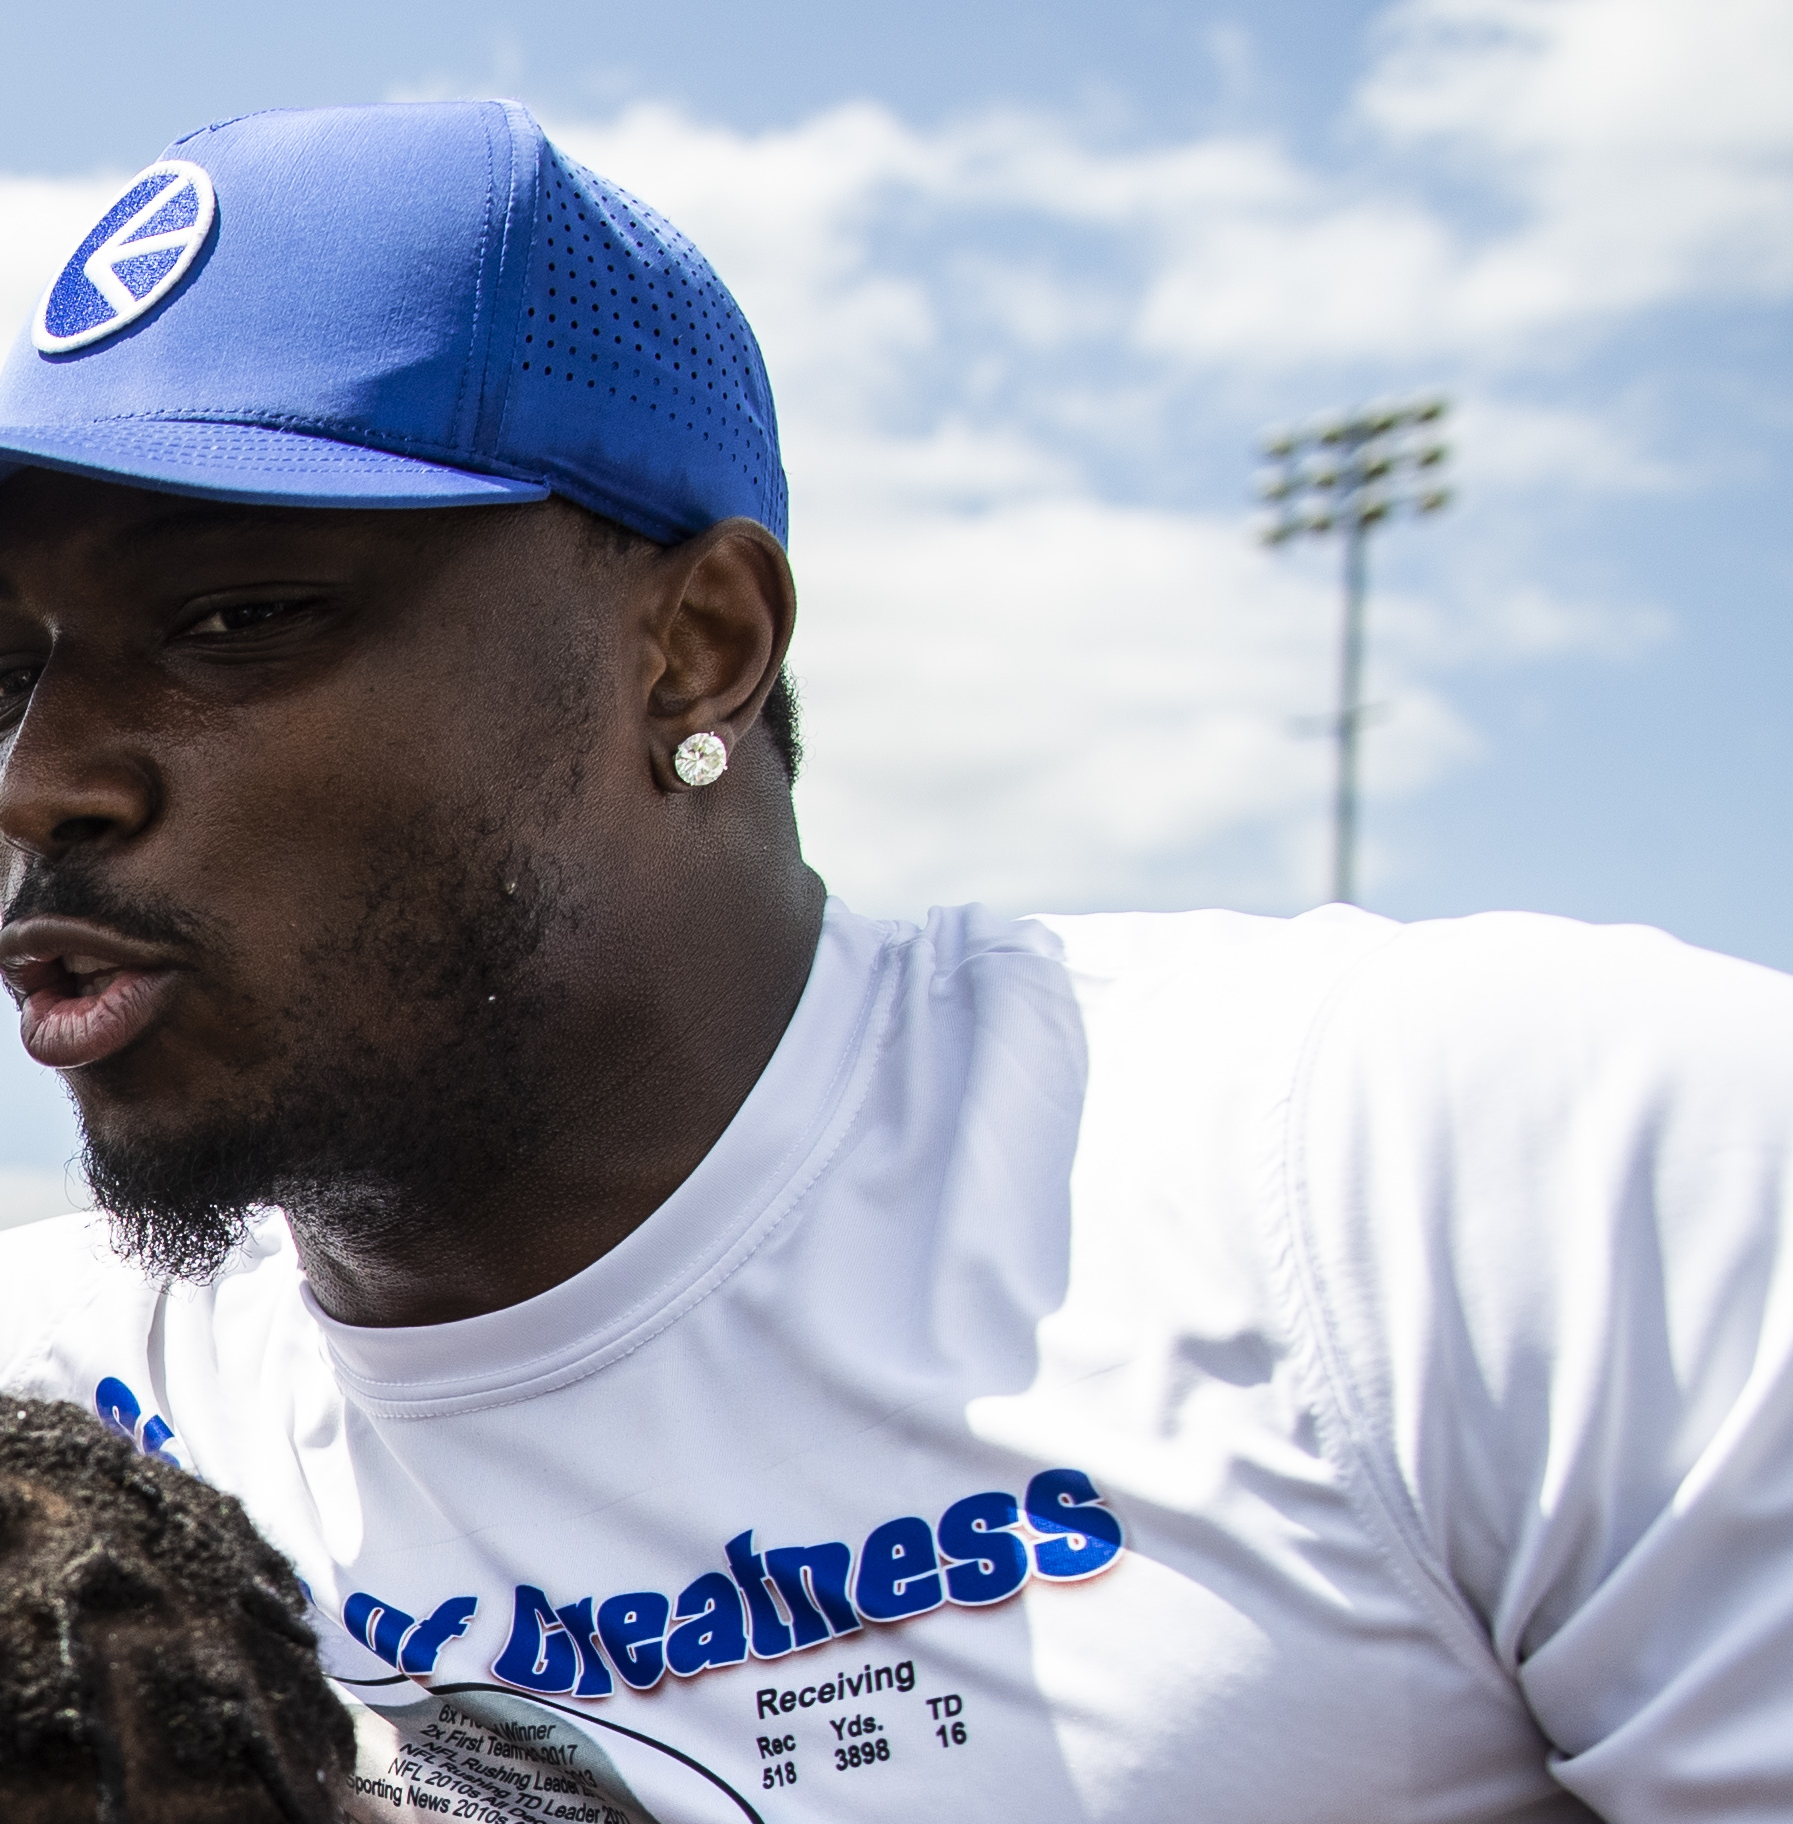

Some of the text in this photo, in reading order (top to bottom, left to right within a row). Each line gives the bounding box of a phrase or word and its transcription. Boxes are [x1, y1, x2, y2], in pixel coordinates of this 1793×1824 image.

[492, 1468, 1123, 1697] Greatness
[756, 1660, 915, 1719] Receiving
[421, 1724, 445, 1742] 2x
[445, 1729, 485, 1754] First
[756, 1694, 962, 1759] Rec Yds. TD
[762, 1721, 967, 1789] 518 3898 16
[346, 1774, 403, 1807] Sporting
[406, 1785, 451, 1813] News
[387, 1757, 421, 1782] NFL
[425, 1771, 481, 1799] 2010s
[479, 1796, 509, 1810] All
[399, 1743, 436, 1765] NFL
[438, 1762, 511, 1799] Rushing
[514, 1792, 542, 1810] TD
[543, 1799, 600, 1824] Leader
[421, 1741, 458, 1763] NFL
[461, 1757, 532, 1791] Rushing
[533, 1771, 580, 1796] Leader
